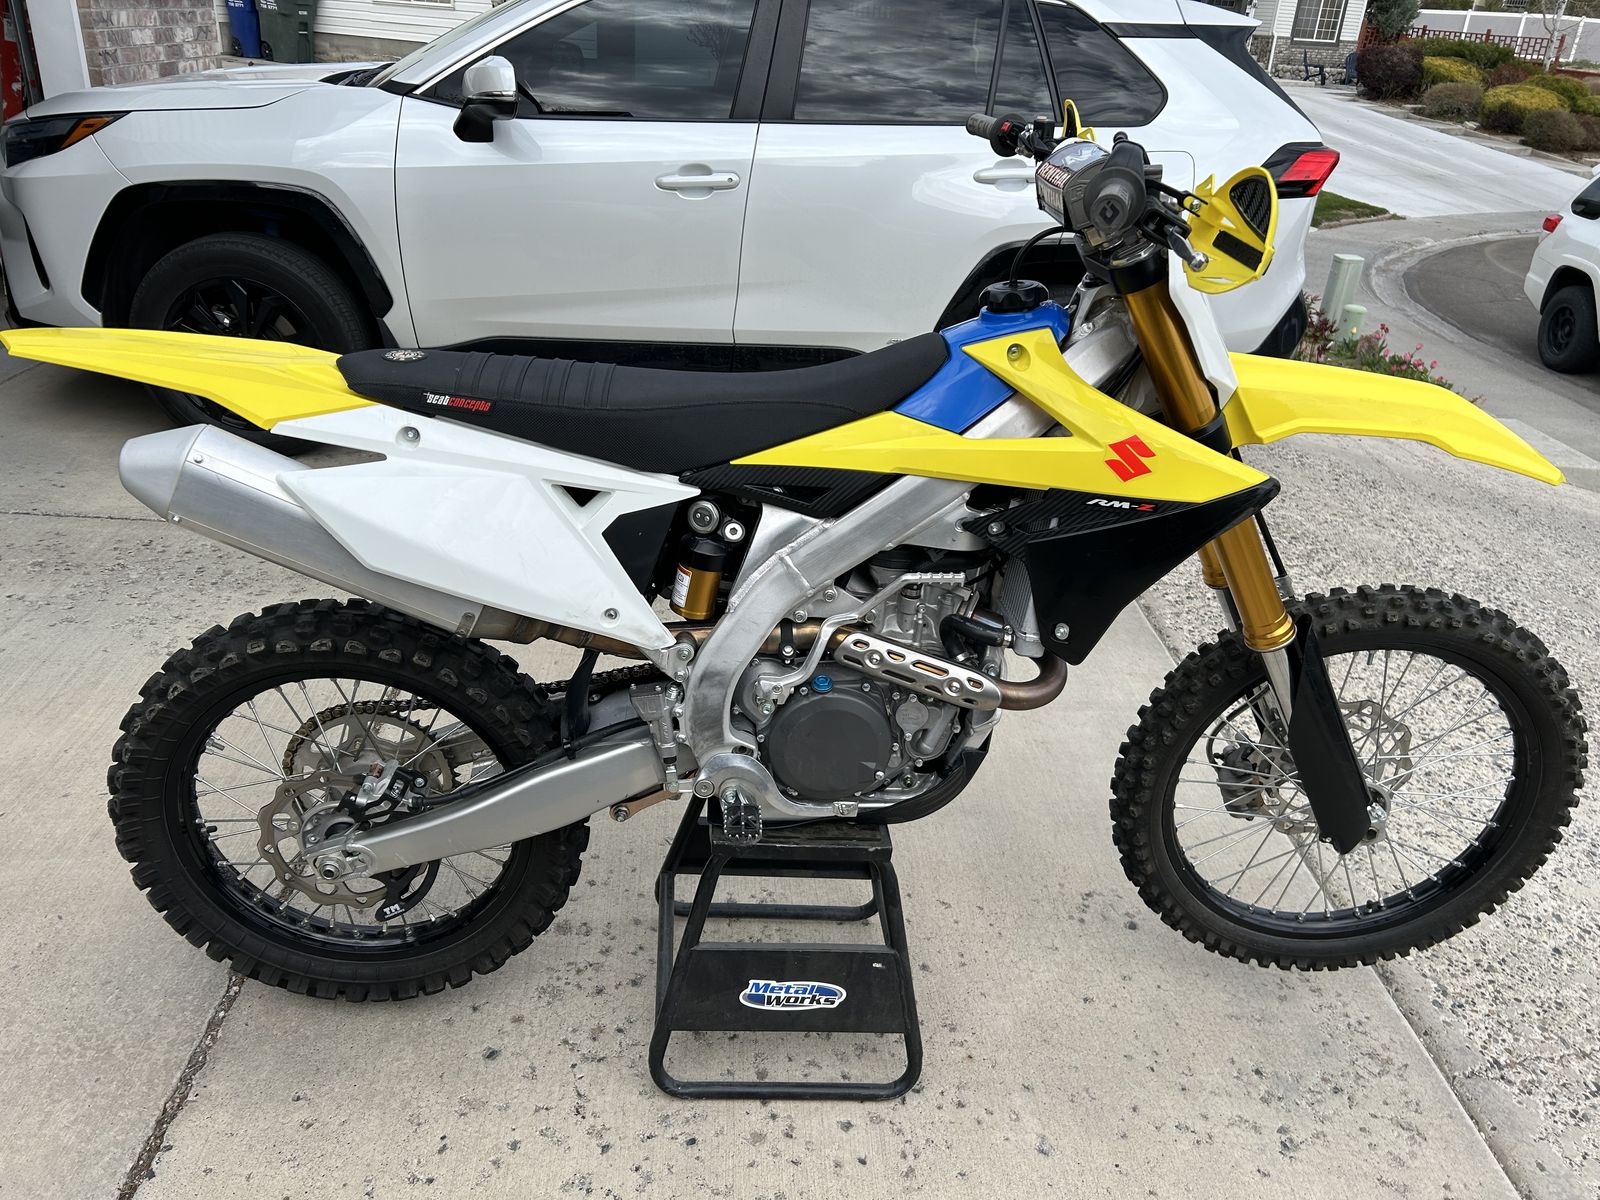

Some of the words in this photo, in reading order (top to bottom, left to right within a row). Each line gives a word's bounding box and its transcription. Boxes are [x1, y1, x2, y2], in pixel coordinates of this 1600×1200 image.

[1037, 162, 1071, 188] RENTHAL
[1086, 498, 1156, 512] RM-Z
[383, 903, 400, 915] TM
[749, 982, 817, 995] Metal
